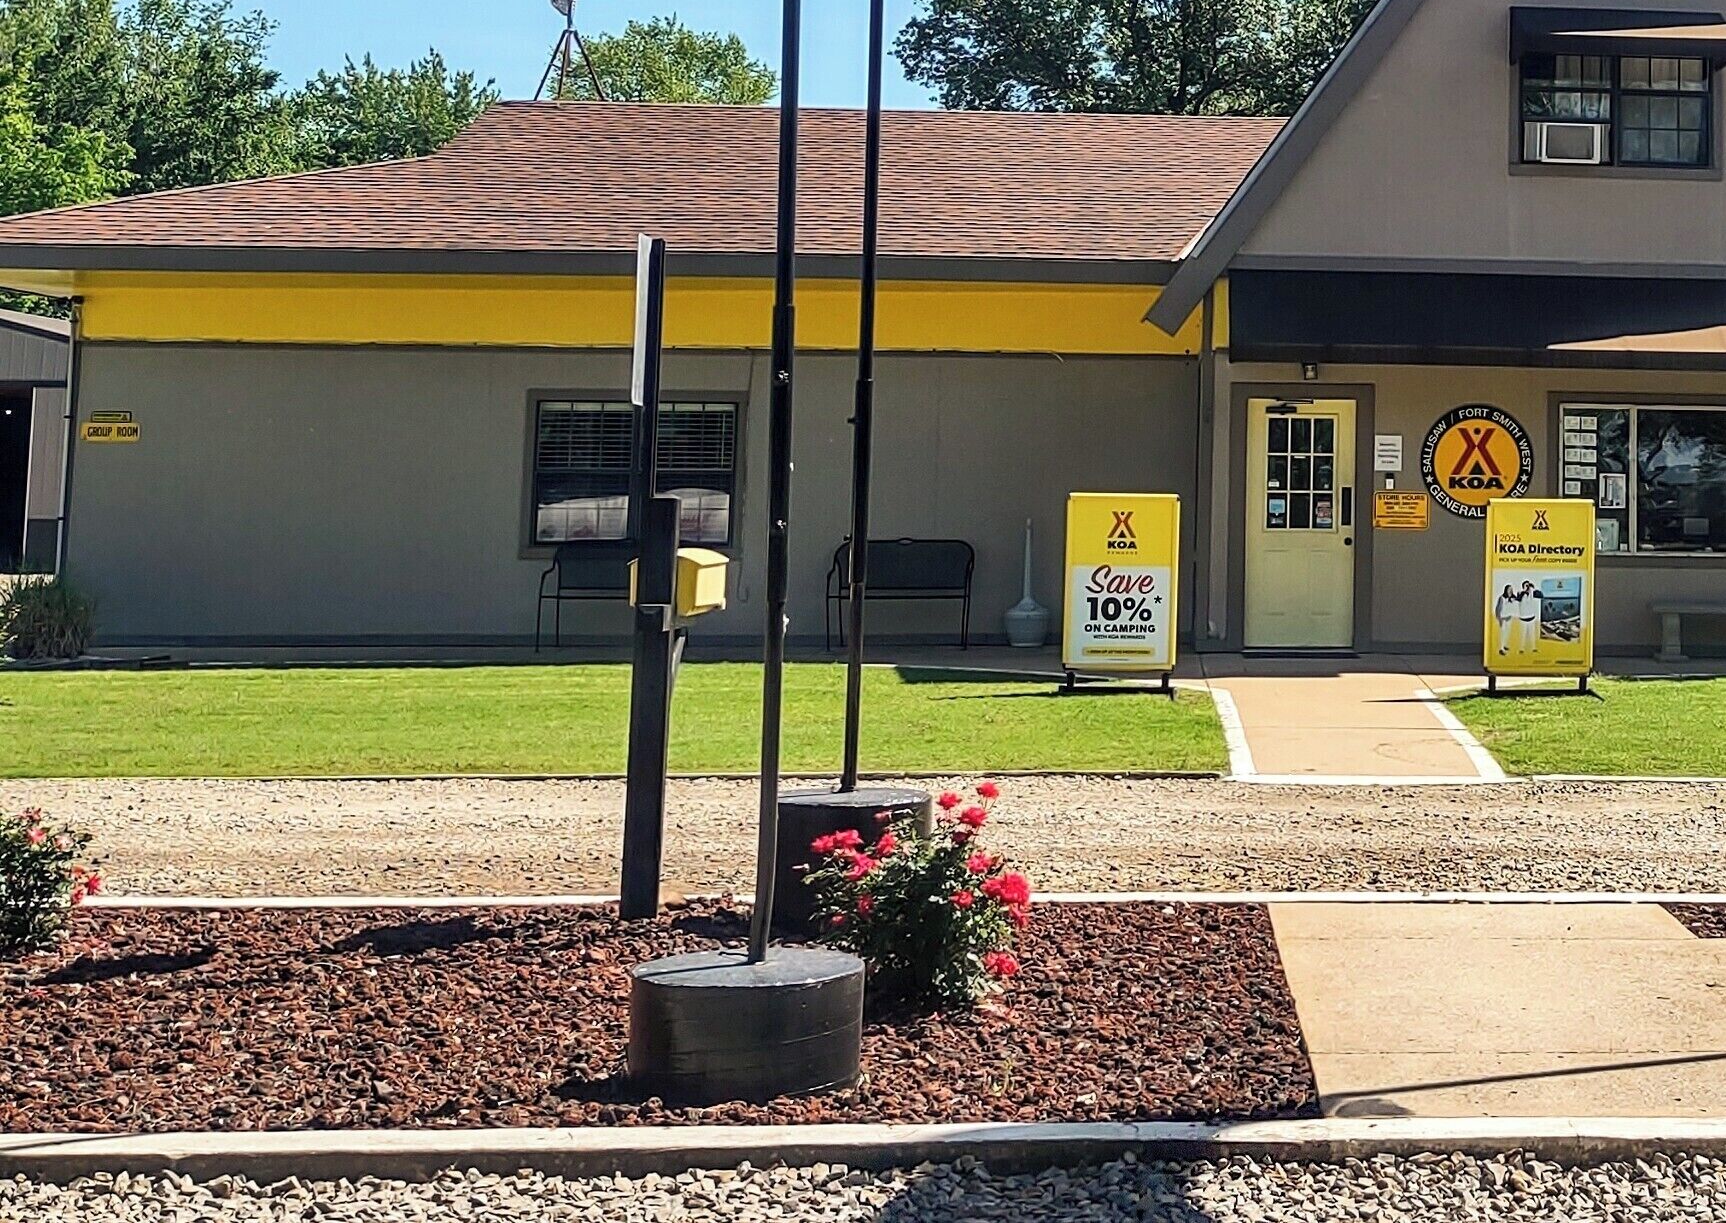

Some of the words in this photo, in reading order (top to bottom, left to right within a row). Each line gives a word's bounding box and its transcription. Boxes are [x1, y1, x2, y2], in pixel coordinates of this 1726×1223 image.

[87, 426, 112, 437] GROUP
[117, 426, 138, 437] ROOM
[1423, 420, 1447, 473] SALLISAW
[1458, 408, 1490, 419] FORT
[1491, 411, 1523, 438] SMITH
[1518, 438, 1532, 473] WEST
[1448, 476, 1505, 489] KOA
[1429, 484, 1486, 517] GENERAL
[1107, 540, 1137, 549] KOA
[1499, 534, 1522, 542] 2025
[1499, 544, 1525, 554] KOA
[1528, 543, 1585, 557] Directory
[1085, 564, 1154, 595] Save
[1084, 624, 1101, 633] ON
[1103, 624, 1156, 633] CAMPING
